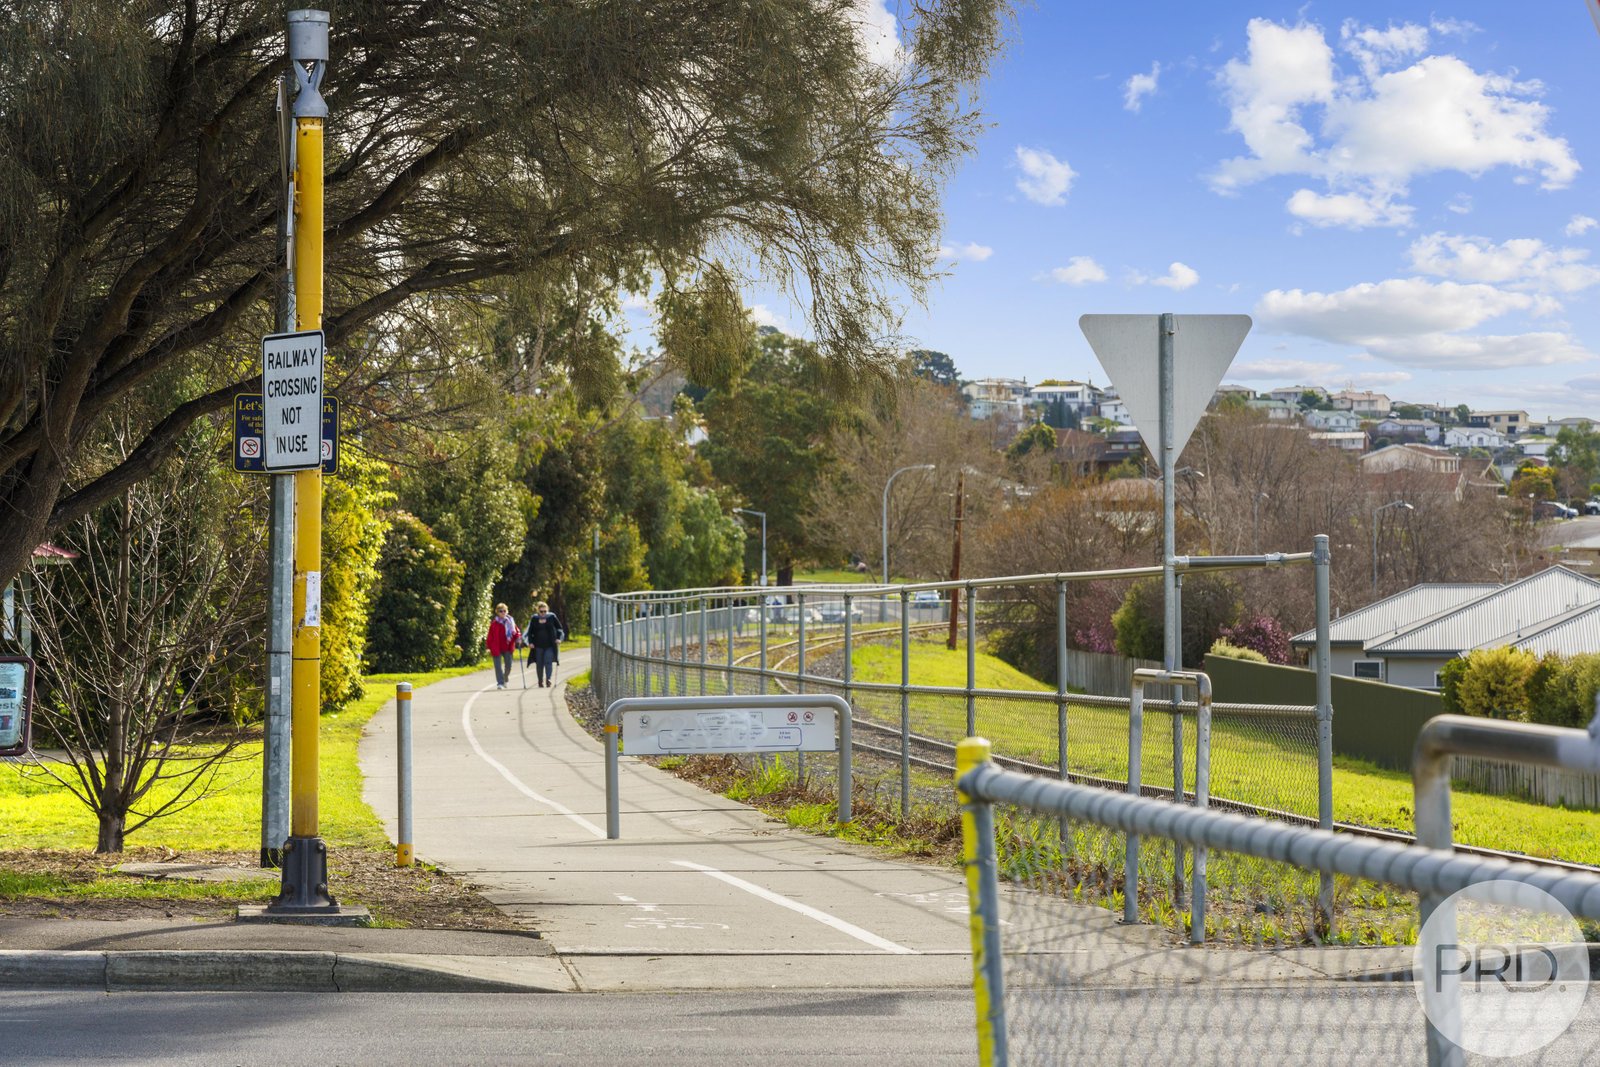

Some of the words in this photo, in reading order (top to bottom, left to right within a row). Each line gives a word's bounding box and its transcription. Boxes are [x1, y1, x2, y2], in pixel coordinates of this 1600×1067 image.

[267, 347, 318, 370] RAILWAY
[267, 376, 317, 398] CROSSING
[239, 400, 263, 411] Let's
[281, 406, 302, 425] NOT
[276, 436, 287, 454] IN
[287, 434, 308, 453] USE
